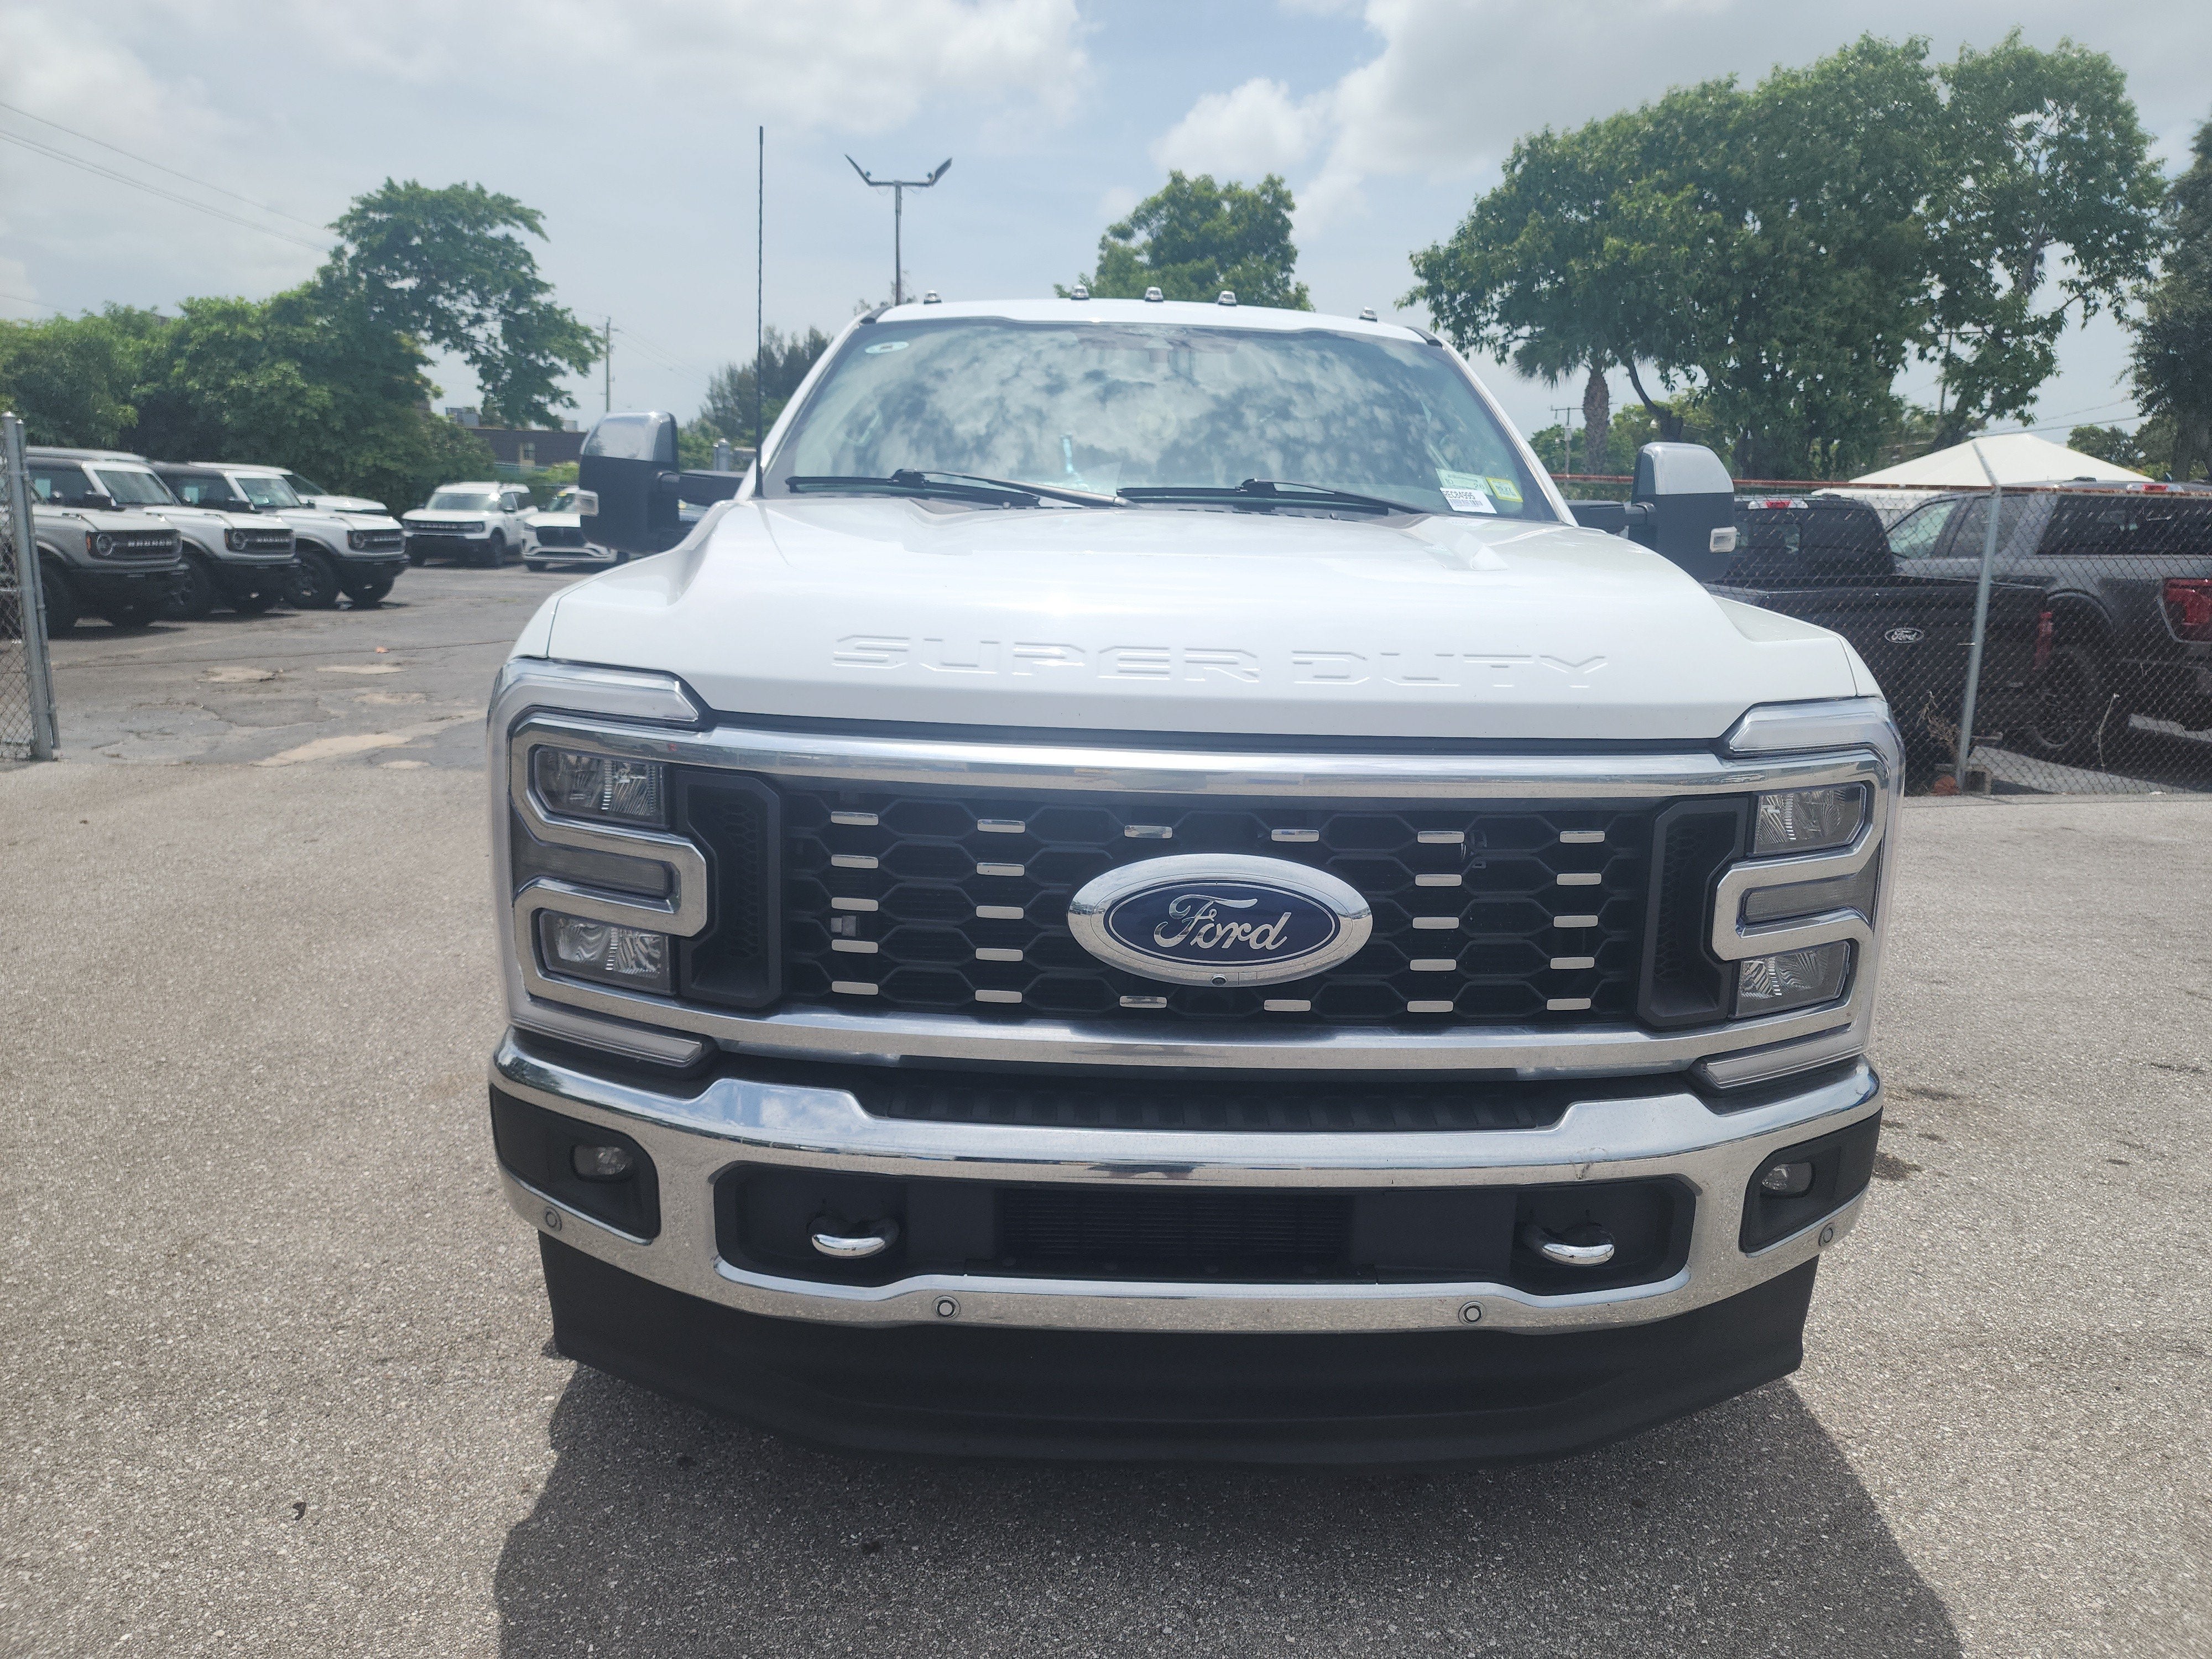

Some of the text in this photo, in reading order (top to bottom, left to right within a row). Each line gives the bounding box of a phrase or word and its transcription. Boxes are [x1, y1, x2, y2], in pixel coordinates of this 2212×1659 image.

[832, 634, 1608, 688] SUPER DUTY
[1154, 894, 1292, 950] Ford
